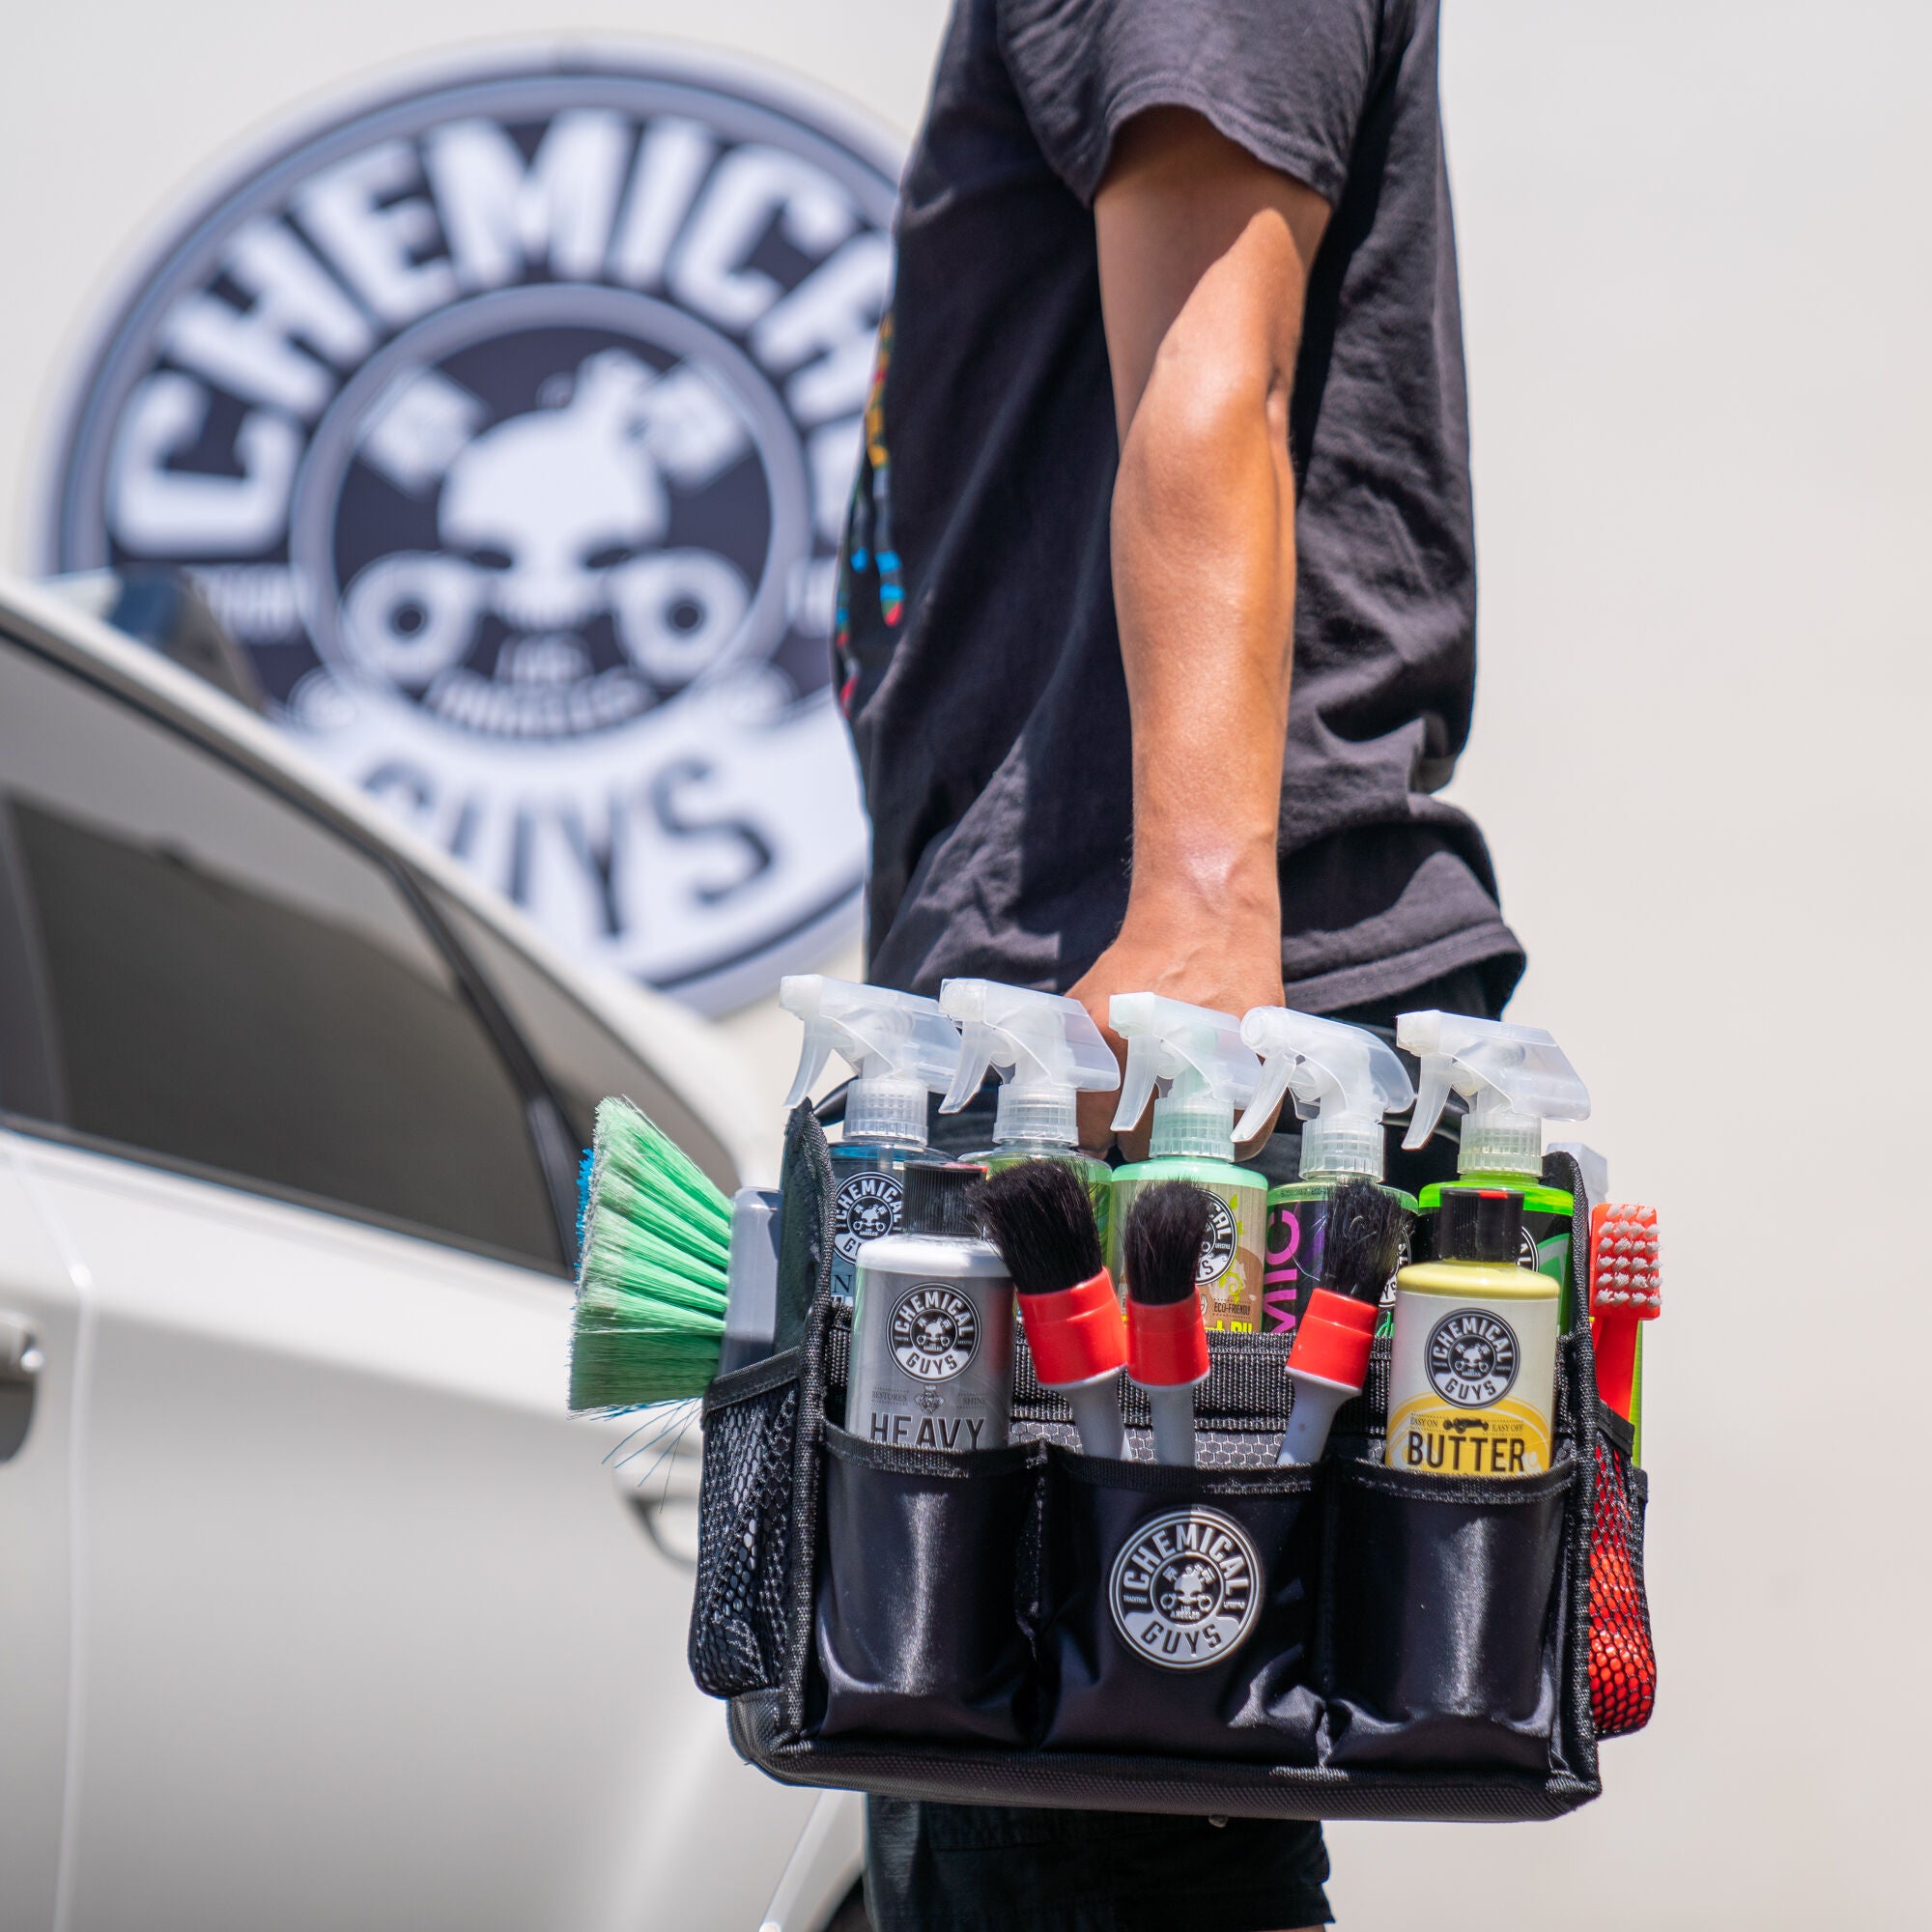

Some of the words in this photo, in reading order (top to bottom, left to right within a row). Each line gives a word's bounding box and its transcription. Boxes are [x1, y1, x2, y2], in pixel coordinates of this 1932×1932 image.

[105, 106, 895, 554] CHEMICA
[894, 1291, 975, 1337] CHEMICAL
[1213, 1302, 1251, 1316] ECO-FRIENDLY
[1433, 1317, 1513, 1362] CHEMICAL
[905, 1351, 958, 1375] GUYS
[871, 1390, 908, 1402] RESTORES
[1444, 1378, 1496, 1400] GUYS
[1410, 1417, 1426, 1426] EASY
[1510, 1424, 1524, 1433] OFF
[1406, 1431, 1525, 1473] BUTTER
[1122, 1523, 1249, 1595] CHEMICAL
[1140, 1620, 1222, 1655] GUYS
